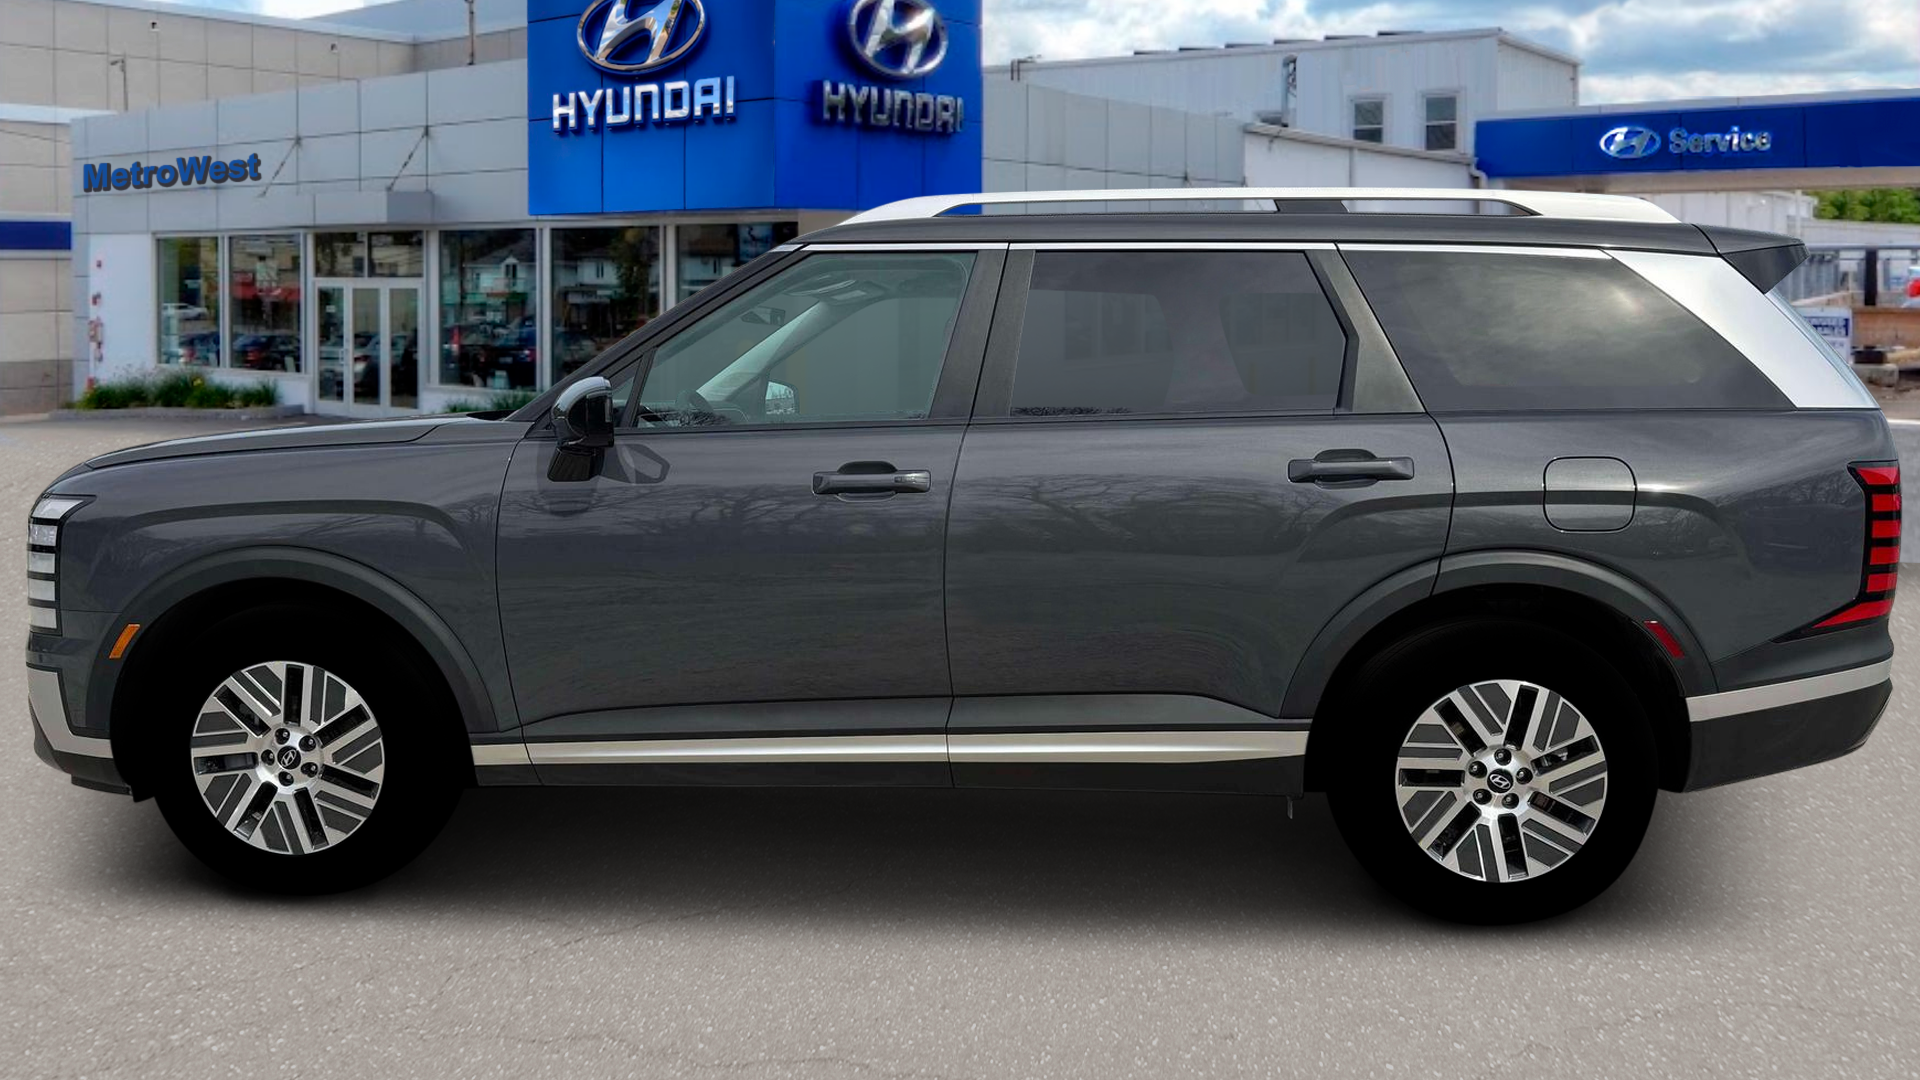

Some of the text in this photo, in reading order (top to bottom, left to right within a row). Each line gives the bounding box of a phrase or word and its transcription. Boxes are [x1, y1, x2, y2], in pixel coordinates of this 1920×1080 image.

[553, 76, 735, 131] HYUNDAI
[823, 80, 964, 133] HYUNDAI
[1668, 126, 1772, 153] Service
[83, 153, 262, 193] MetroWest
